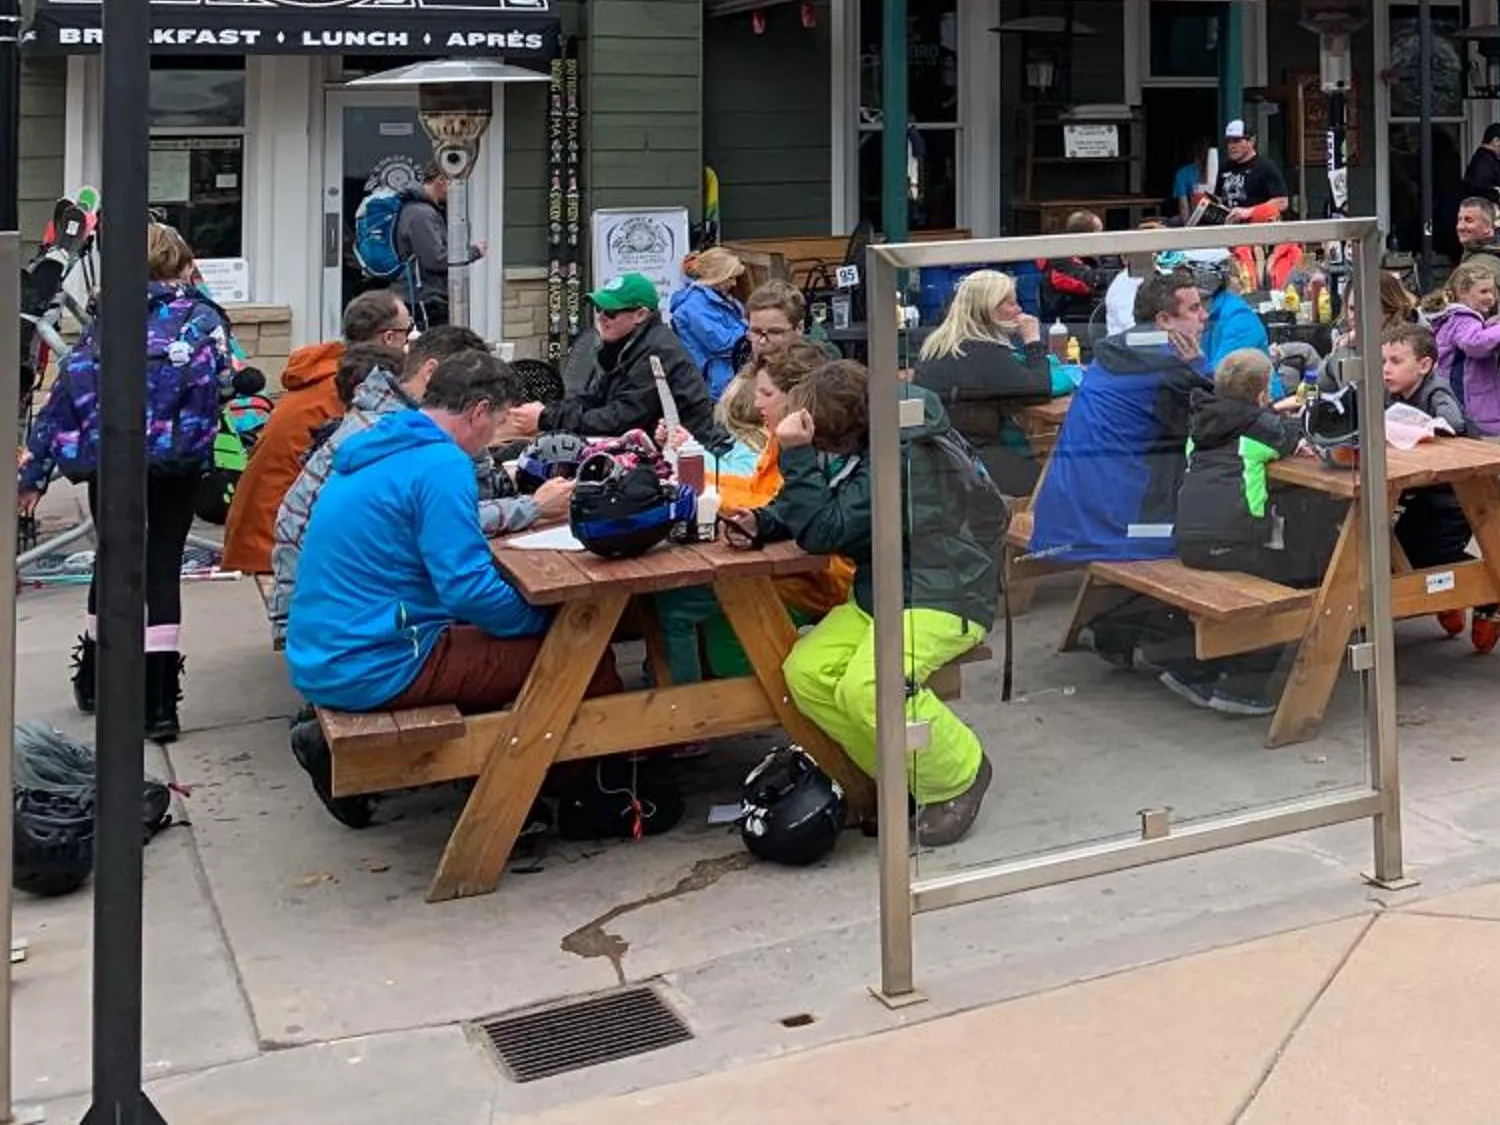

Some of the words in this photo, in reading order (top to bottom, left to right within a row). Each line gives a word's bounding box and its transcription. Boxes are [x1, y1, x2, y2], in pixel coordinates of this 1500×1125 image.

[59, 28, 262, 45] BRKFAST
[302, 30, 409, 46] LUNCH
[446, 29, 544, 49] APRÈS
